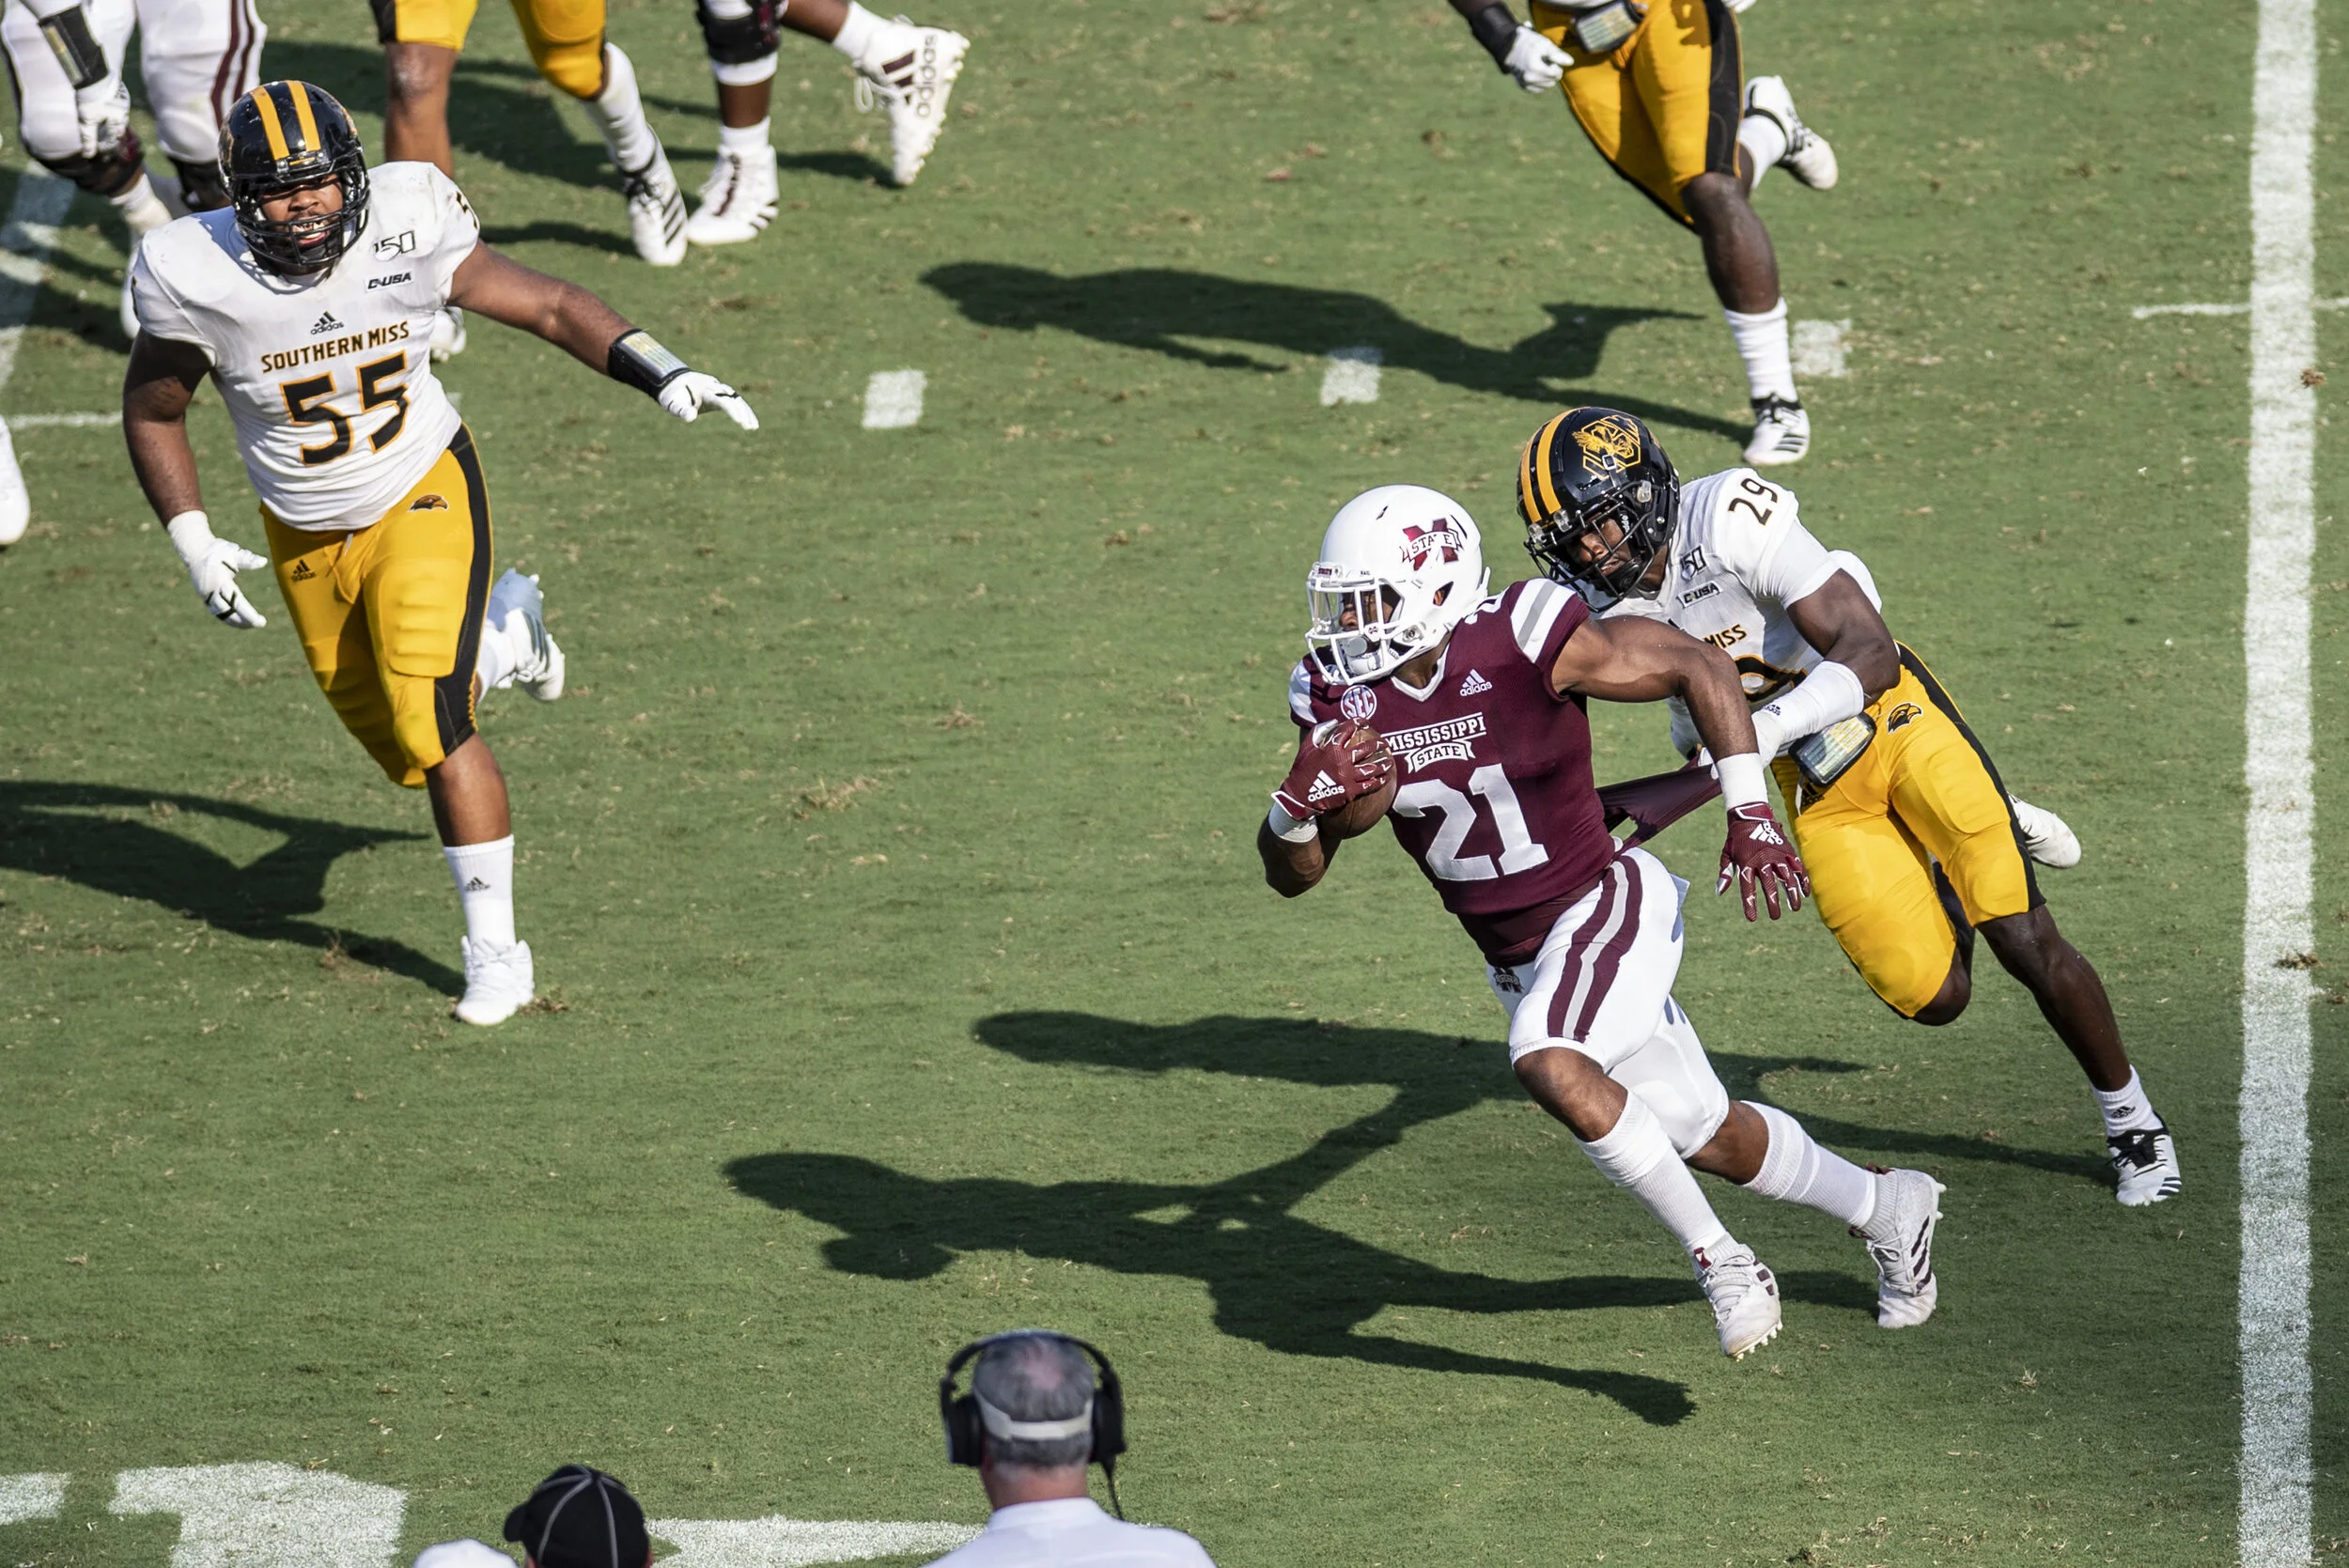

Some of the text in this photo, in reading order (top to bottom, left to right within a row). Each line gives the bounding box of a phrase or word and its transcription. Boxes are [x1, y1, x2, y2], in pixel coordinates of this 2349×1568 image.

[310, 320, 345, 335] adidas
[260, 318, 411, 374] SOUTHERN MISS
[278, 349, 412, 467] 55
[1727, 476, 1778, 526] 29
[1411, 533, 1454, 554] STAE
[1703, 623, 1748, 649] MISS
[1344, 687, 1375, 719] SEC
[1459, 681, 1493, 697] adidas
[1385, 716, 1486, 752] MISSISSIPPI
[1417, 745, 1462, 767] STATE
[1307, 784, 1346, 802] adidas
[1392, 762, 1549, 882] 21
